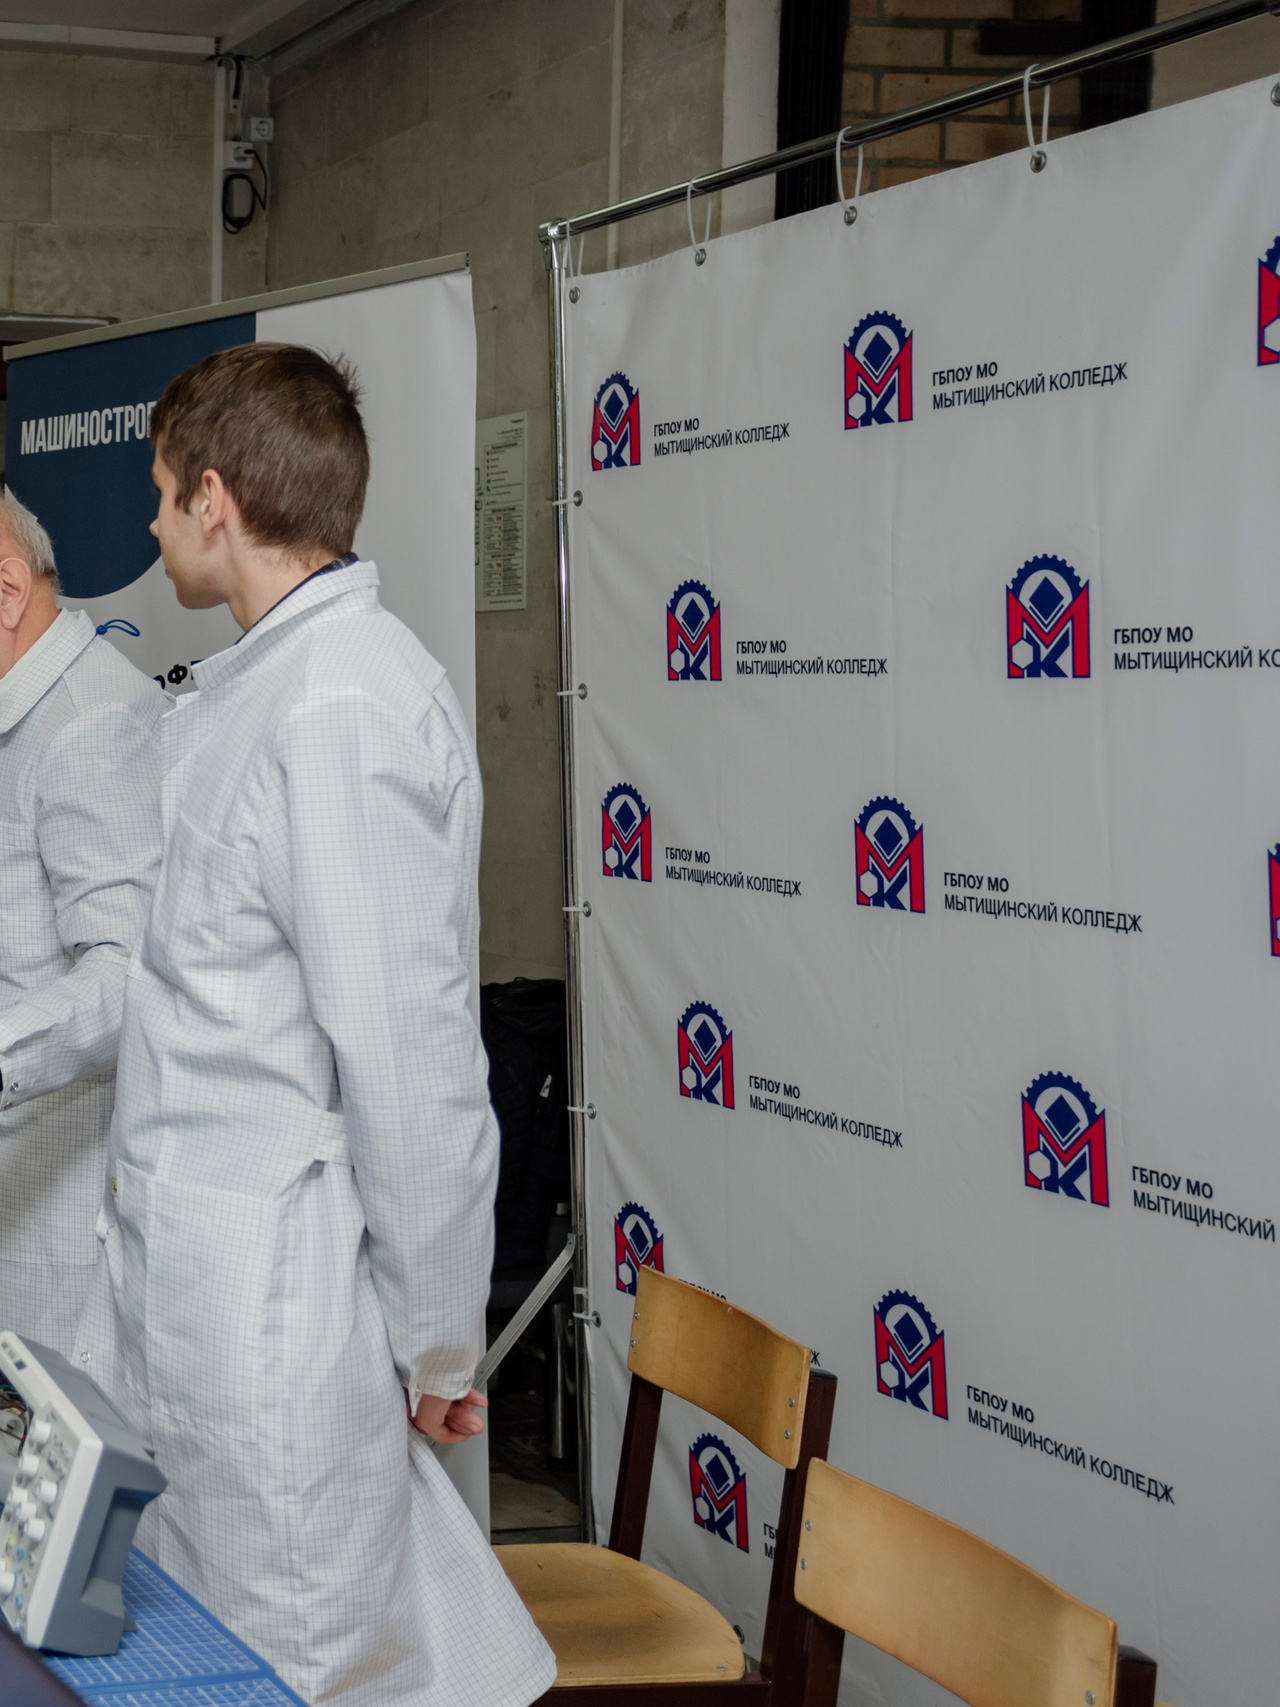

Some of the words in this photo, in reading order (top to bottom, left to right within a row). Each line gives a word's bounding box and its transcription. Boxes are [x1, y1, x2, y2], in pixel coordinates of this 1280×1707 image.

[932, 365, 973, 387] ГБПОУ
[976, 361, 999, 380] МО
[932, 372, 1045, 410] МЫТИЩИНСКИЙ
[1049, 361, 1128, 392] КОЛЛЕДЖ
[653, 420, 683, 440] ГБПОУ
[683, 418, 701, 433] МО
[653, 427, 733, 457] МЫТИЩИНСКИЙ
[734, 422, 790, 445] КОЛЛЕДЖ
[736, 640, 768, 655] ГБПОУ
[769, 639, 787, 654] МО
[1113, 626, 1163, 645] ГБПОУ
[1166, 625, 1194, 643] МО
[736, 656, 824, 679] МЫТИЩИНСКИЙ
[826, 658, 888, 678] КОЛЛЕДЖ
[1114, 645, 1253, 672] МЫТИЩИНСКИЙ
[665, 846, 693, 862] ГБПОУ
[694, 850, 711, 865] МО
[665, 864, 745, 889] МЫТИЩИНСКИЙ
[746, 875, 802, 898] КОЛЛЕДЖ
[943, 871, 984, 890] ГБПОУ
[987, 876, 1010, 893] МО
[944, 893, 1058, 923] МЫТИЩИНСКИЙ
[1061, 906, 1143, 935] КОЛЛЕДЖ
[748, 1074, 781, 1097] ГБПОУ
[783, 1082, 801, 1099] МО
[749, 1094, 839, 1131] МЫТИЩИНСКИЙ
[840, 1117, 904, 1149] КОЛЛЕДЖ
[1131, 1165, 1182, 1192] ГБПОУ
[1185, 1178, 1214, 1200] МО
[1132, 1189, 1277, 1244] МЫТИЩИНСКИЙ
[966, 1384, 1009, 1411] ГБПОУ
[1011, 1401, 1035, 1424] МО
[967, 1406, 1086, 1469] МЫТИЩИНСКИЙ
[1089, 1454, 1175, 1505] КОЛЛЕДЖ
